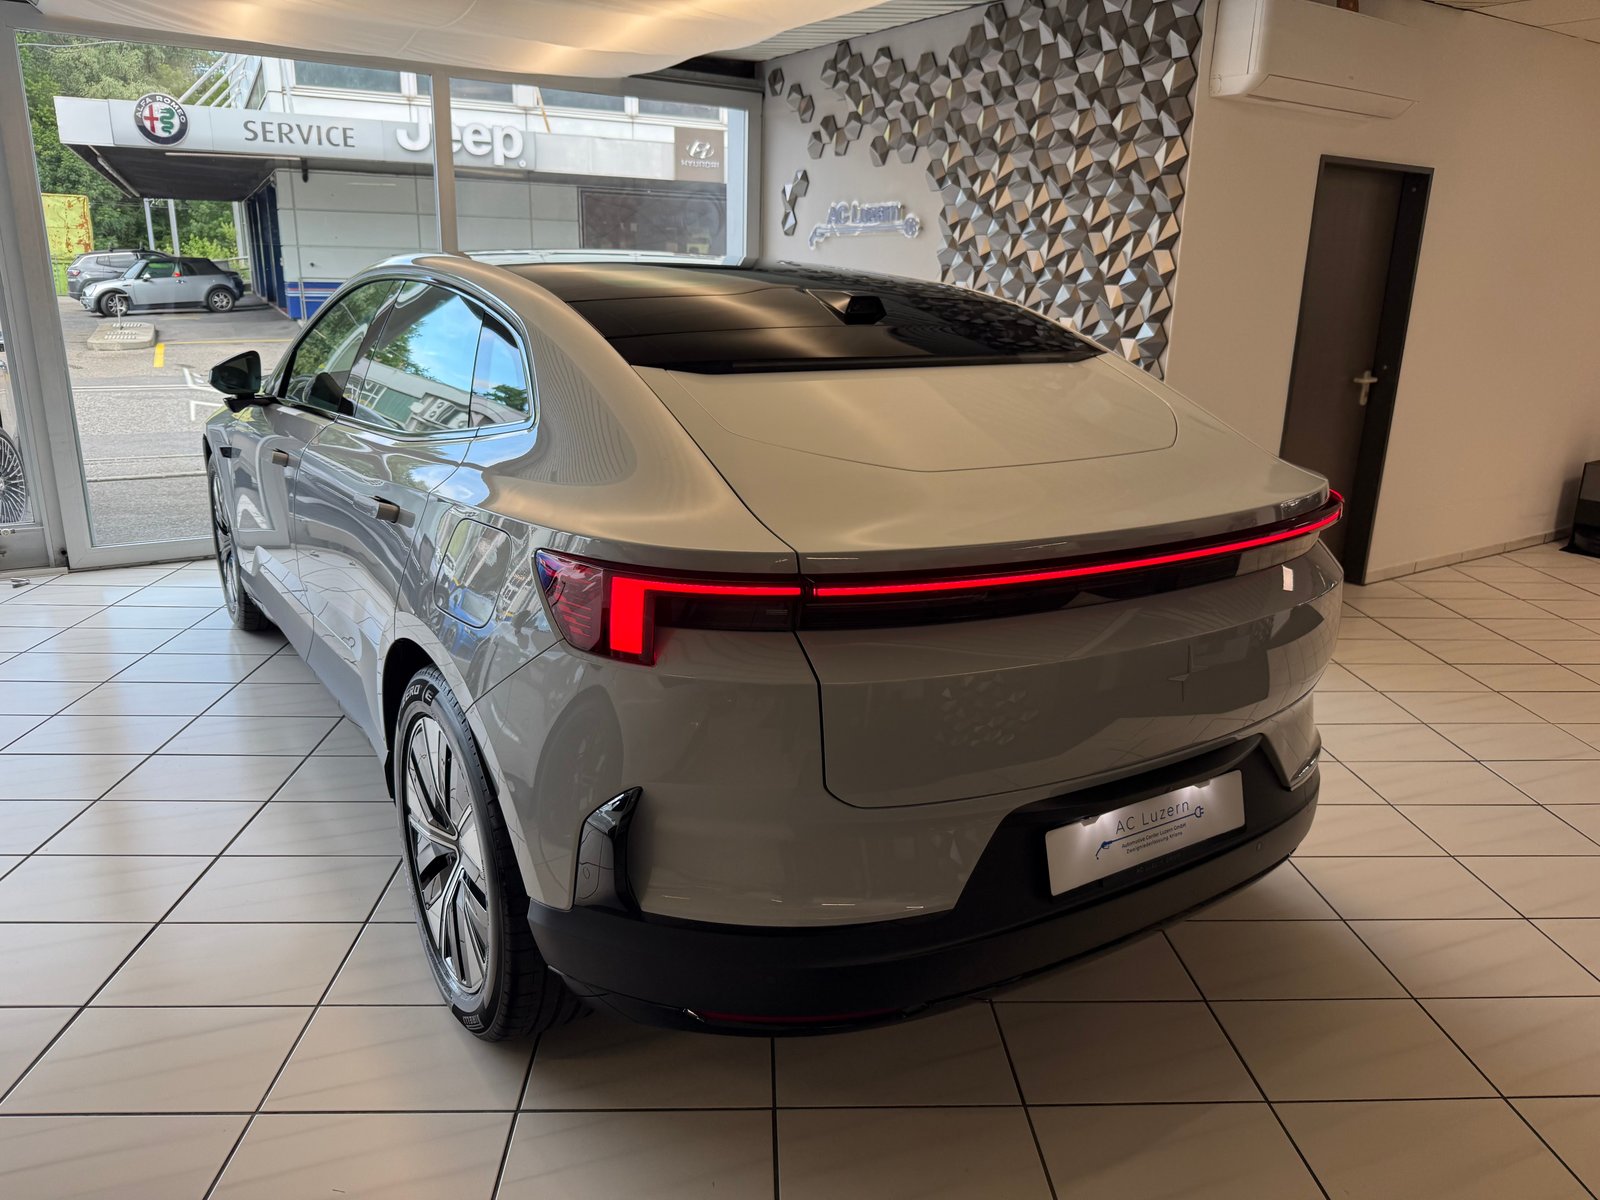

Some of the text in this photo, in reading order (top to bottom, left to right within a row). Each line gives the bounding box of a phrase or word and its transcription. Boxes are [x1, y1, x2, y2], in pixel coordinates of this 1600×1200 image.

[136, 95, 186, 123] ALFA ROMEO
[243, 120, 356, 148] SERVICE
[1115, 801, 1190, 835] AC Luzern
